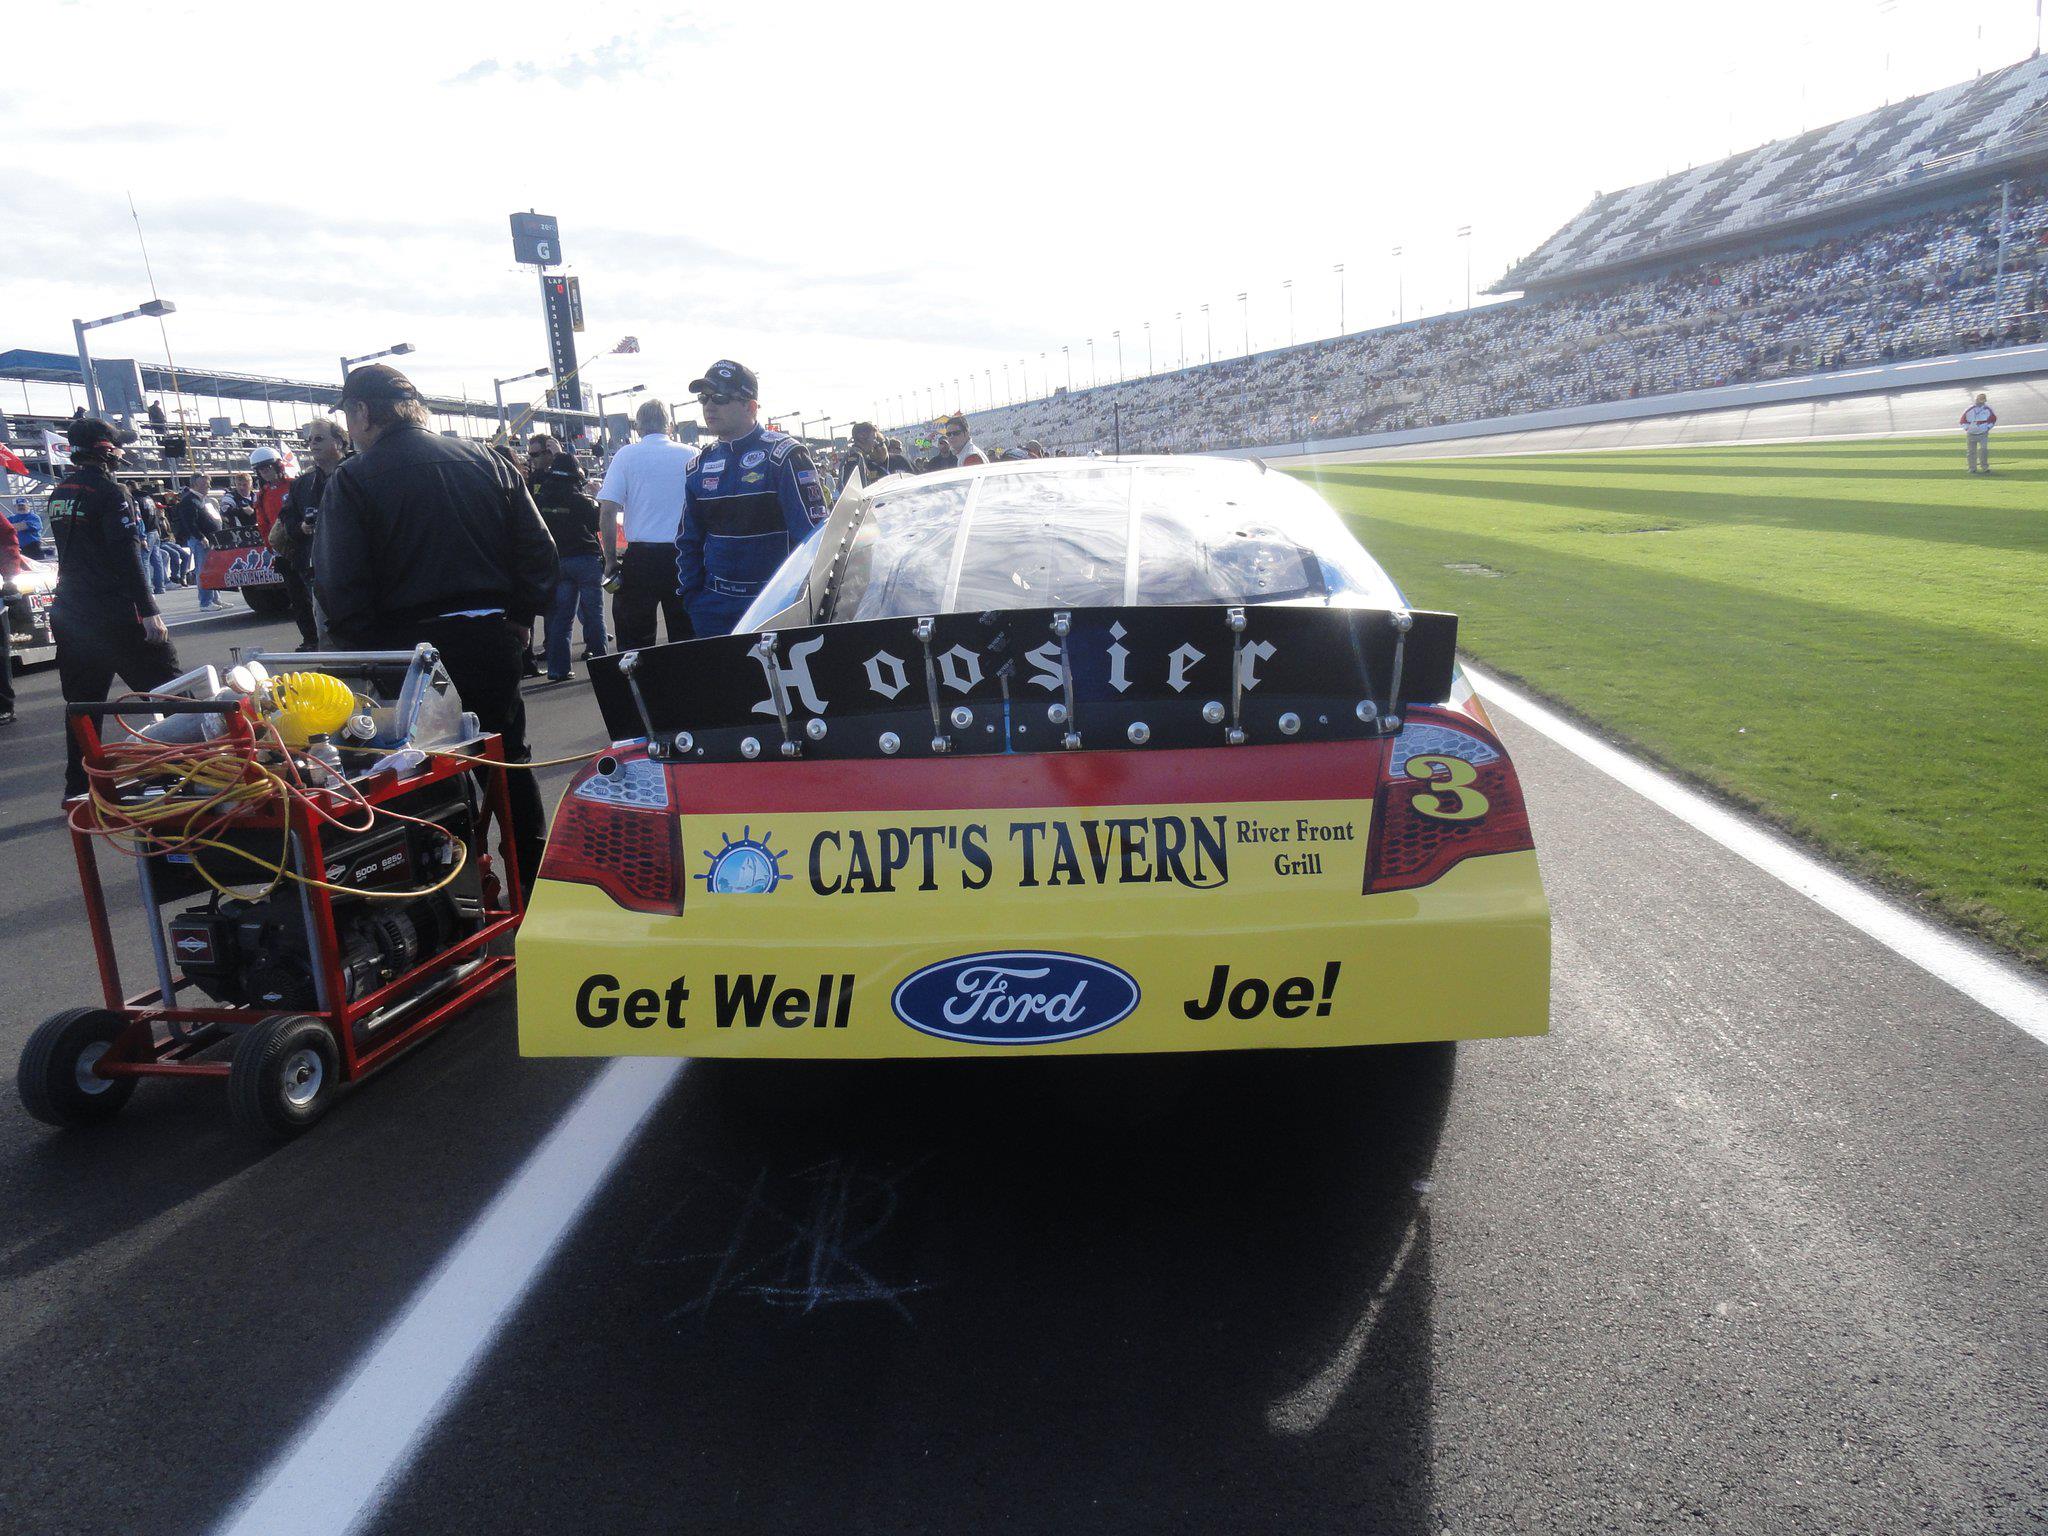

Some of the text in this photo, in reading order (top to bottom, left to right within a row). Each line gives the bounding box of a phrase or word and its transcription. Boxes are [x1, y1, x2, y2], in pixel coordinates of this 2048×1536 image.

[536, 242, 550, 260] G
[746, 619, 1278, 716] Hoosier
[1404, 753, 1490, 825] 3
[808, 815, 1229, 896] CAPT'S TAVERN
[1236, 818, 1355, 844] River Front
[355, 863, 378, 878] 5000
[381, 852, 403, 867] 6250
[1274, 853, 1323, 877] Grill
[575, 973, 856, 1029] Get Well
[942, 966, 1089, 1024] Ford
[1183, 960, 1342, 1021] Joe!
